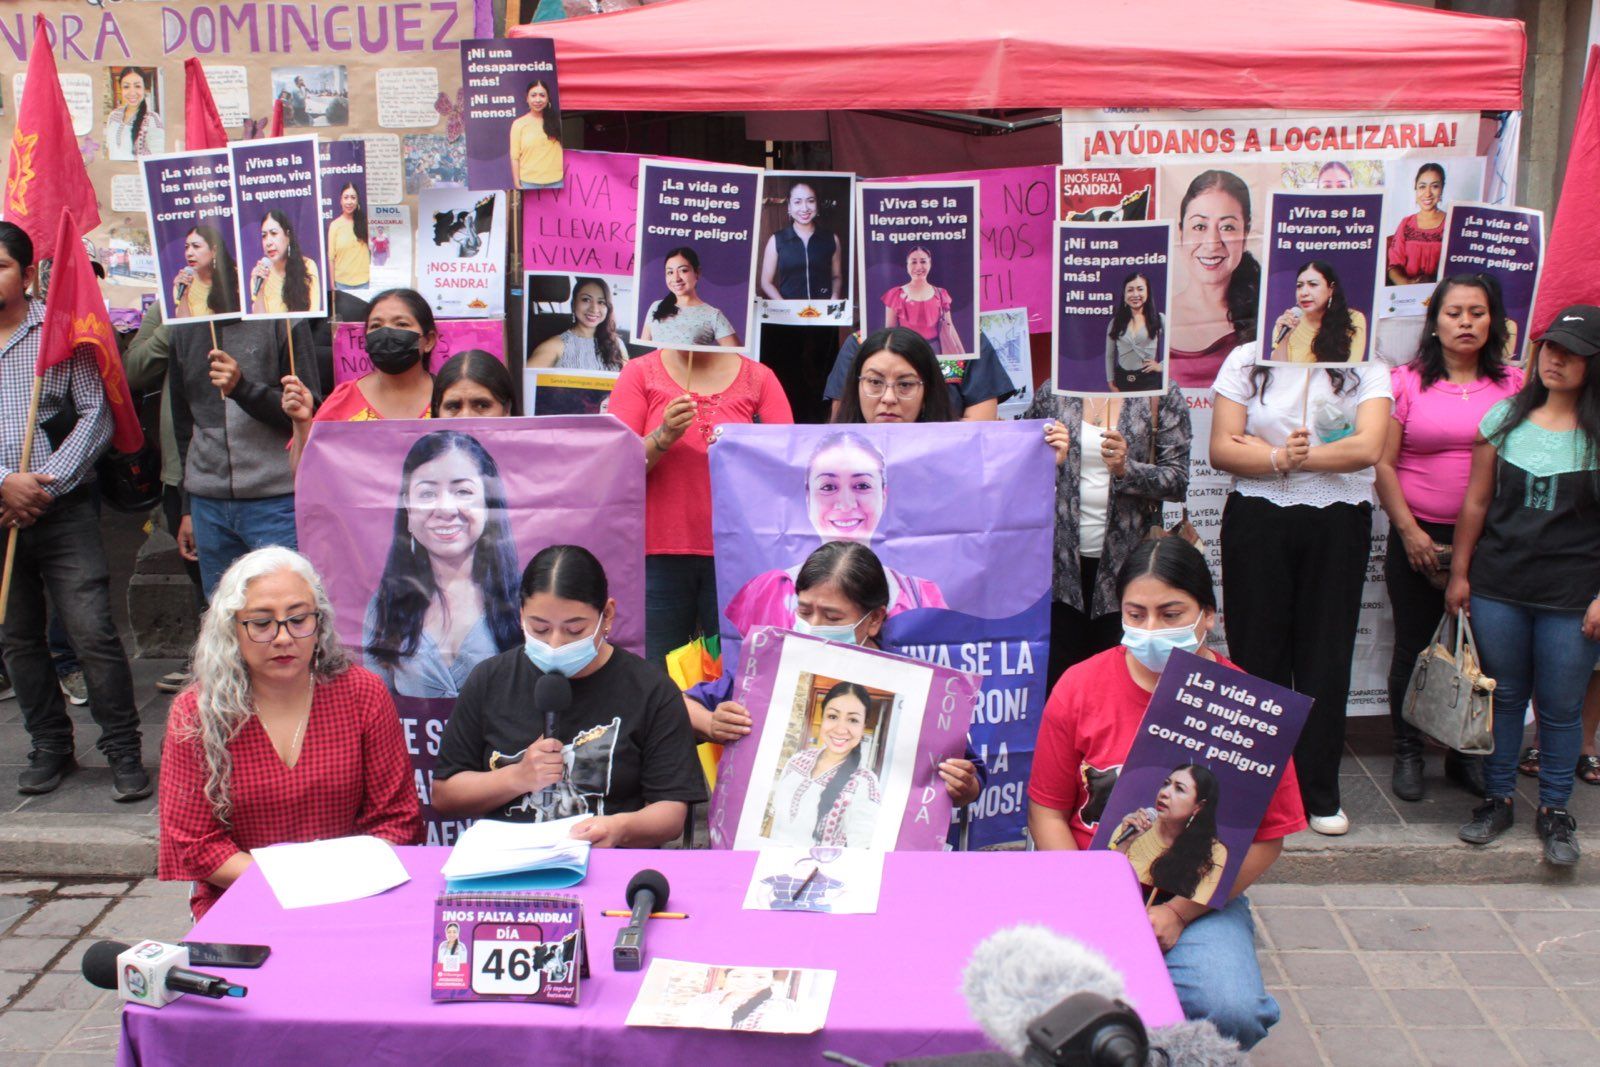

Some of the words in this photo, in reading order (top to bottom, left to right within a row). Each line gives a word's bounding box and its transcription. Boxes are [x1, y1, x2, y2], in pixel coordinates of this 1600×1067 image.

[162, 2, 462, 54] DOMINGUEZ
[468, 48, 486, 61] ¡Ni
[488, 49, 512, 58] una
[468, 61, 553, 74] desaparecida
[469, 76, 500, 87] más!
[470, 94, 489, 106] ¡Ni
[491, 95, 515, 104] una
[470, 107, 516, 118] menos!
[1084, 124, 1236, 162] ¡AYÚDANOS
[1243, 128, 1262, 152] A
[1269, 122, 1458, 151] LOCALIZARLA!
[245, 158, 274, 172] ¡Viva
[276, 157, 289, 166] se
[292, 154, 302, 165] la
[320, 163, 363, 178] parecida
[161, 168, 181, 182] ¡La
[184, 165, 211, 177] vida
[215, 163, 231, 174] de
[239, 171, 287, 186] llevaron,
[288, 169, 312, 181] viva
[1064, 173, 1089, 183] ¡NOS
[1092, 172, 1120, 183] FALTA
[161, 182, 181, 194] las
[241, 190, 253, 202] la
[255, 185, 312, 202] queremos!
[662, 178, 684, 192] ¡La
[688, 180, 718, 194] vida
[721, 181, 739, 194] de
[1064, 183, 1122, 196] SANDRA!
[174, 197, 191, 206] no
[194, 192, 226, 204] debe
[659, 193, 680, 206] las
[683, 197, 741, 211] mujeres
[880, 197, 917, 212] ¡Viva
[921, 198, 938, 209] se
[942, 197, 957, 208] la
[1004, 181, 1050, 216] NO
[157, 211, 196, 222] correr
[670, 212, 688, 222] no
[691, 212, 727, 225] debe
[870, 213, 933, 227] llevaron,
[937, 212, 967, 223] viva
[1289, 206, 1325, 220] ¡Viva
[1331, 208, 1349, 219] se
[1352, 207, 1366, 218] la
[1277, 222, 1341, 236] llevaron,
[1345, 223, 1375, 234] viva
[1465, 216, 1483, 226] ¡La
[1486, 218, 1511, 230] vida
[1514, 220, 1529, 232] de
[648, 224, 691, 238] correr
[694, 228, 748, 242] peligro!
[871, 229, 885, 242] la
[889, 228, 966, 243] queremos!
[1461, 228, 1479, 239] las
[1481, 232, 1529, 245] mujeres
[1064, 237, 1086, 251] ¡Ni
[1090, 239, 1118, 249] una
[1278, 238, 1291, 250] la
[1295, 238, 1372, 253] queremos!
[1470, 243, 1484, 251] no
[1486, 245, 1516, 256] debe
[1064, 252, 1167, 268] desaparecida
[1450, 254, 1485, 265] correr
[1487, 258, 1534, 271] peligro!
[427, 262, 457, 275] ¡NOS
[460, 262, 497, 273] FALTA
[1063, 270, 1101, 282] más!
[434, 277, 488, 289] SANDRA!
[1066, 290, 1084, 302] ¡Ni
[1088, 291, 1113, 301] una
[1065, 304, 1114, 315] menos!
[1188, 488, 1223, 497] CICATRIZ
[960, 641, 992, 676] SE
[1001, 640, 1034, 676] LA
[1185, 671, 1215, 692] ¡La
[1220, 684, 1257, 707] vida
[1260, 698, 1283, 716] de
[1175, 688, 1203, 709] las
[1206, 702, 1278, 736] mujeres
[1184, 714, 1206, 731] no
[1211, 725, 1255, 749] debe
[1148, 724, 1205, 751] correr
[1205, 744, 1276, 778] peligro!
[951, 781, 1023, 824] MOS!
[442, 911, 474, 922] ¡NOS
[477, 911, 515, 923] FALTA
[517, 912, 573, 924] SANDRA!
[496, 925, 520, 940] DÍA
[481, 947, 532, 981] 46
